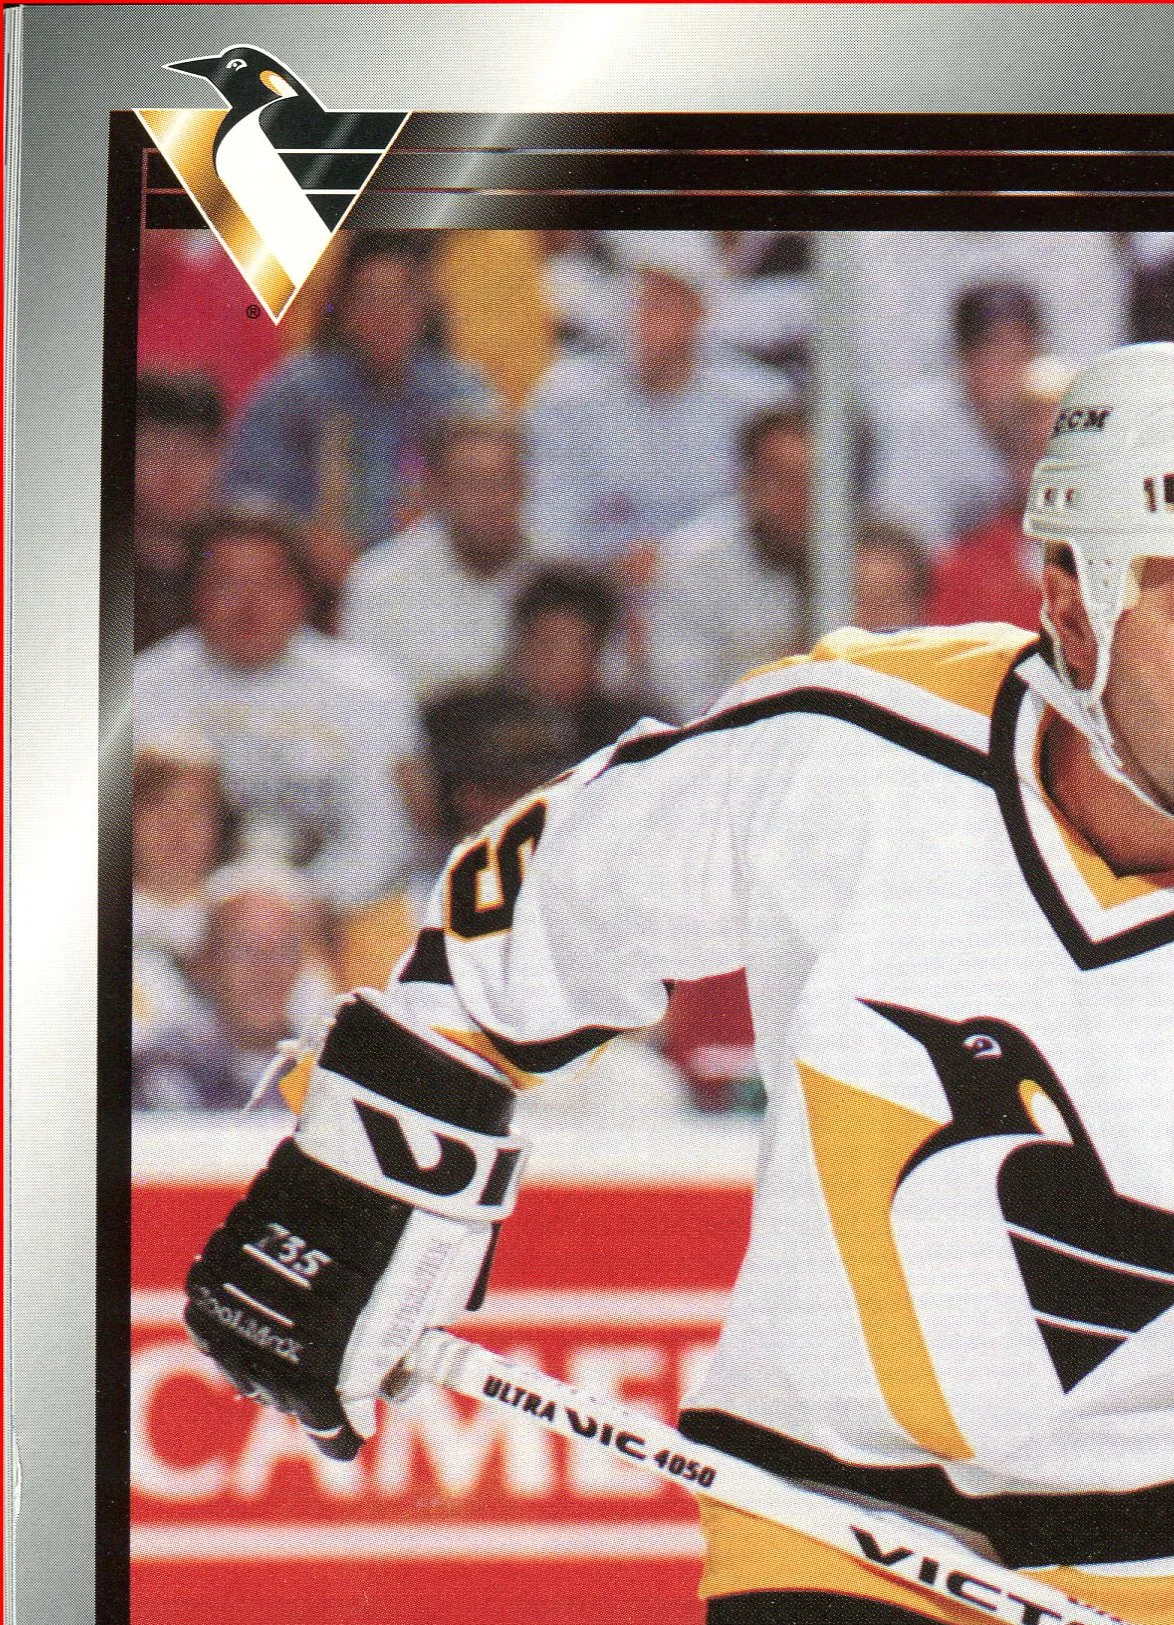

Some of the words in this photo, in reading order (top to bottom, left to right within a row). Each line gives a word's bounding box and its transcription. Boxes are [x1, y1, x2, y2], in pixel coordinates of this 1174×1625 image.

[252, 1222, 334, 1277] 735
[482, 1374, 557, 1423] ULTRA
[654, 1449, 717, 1489] 4050
